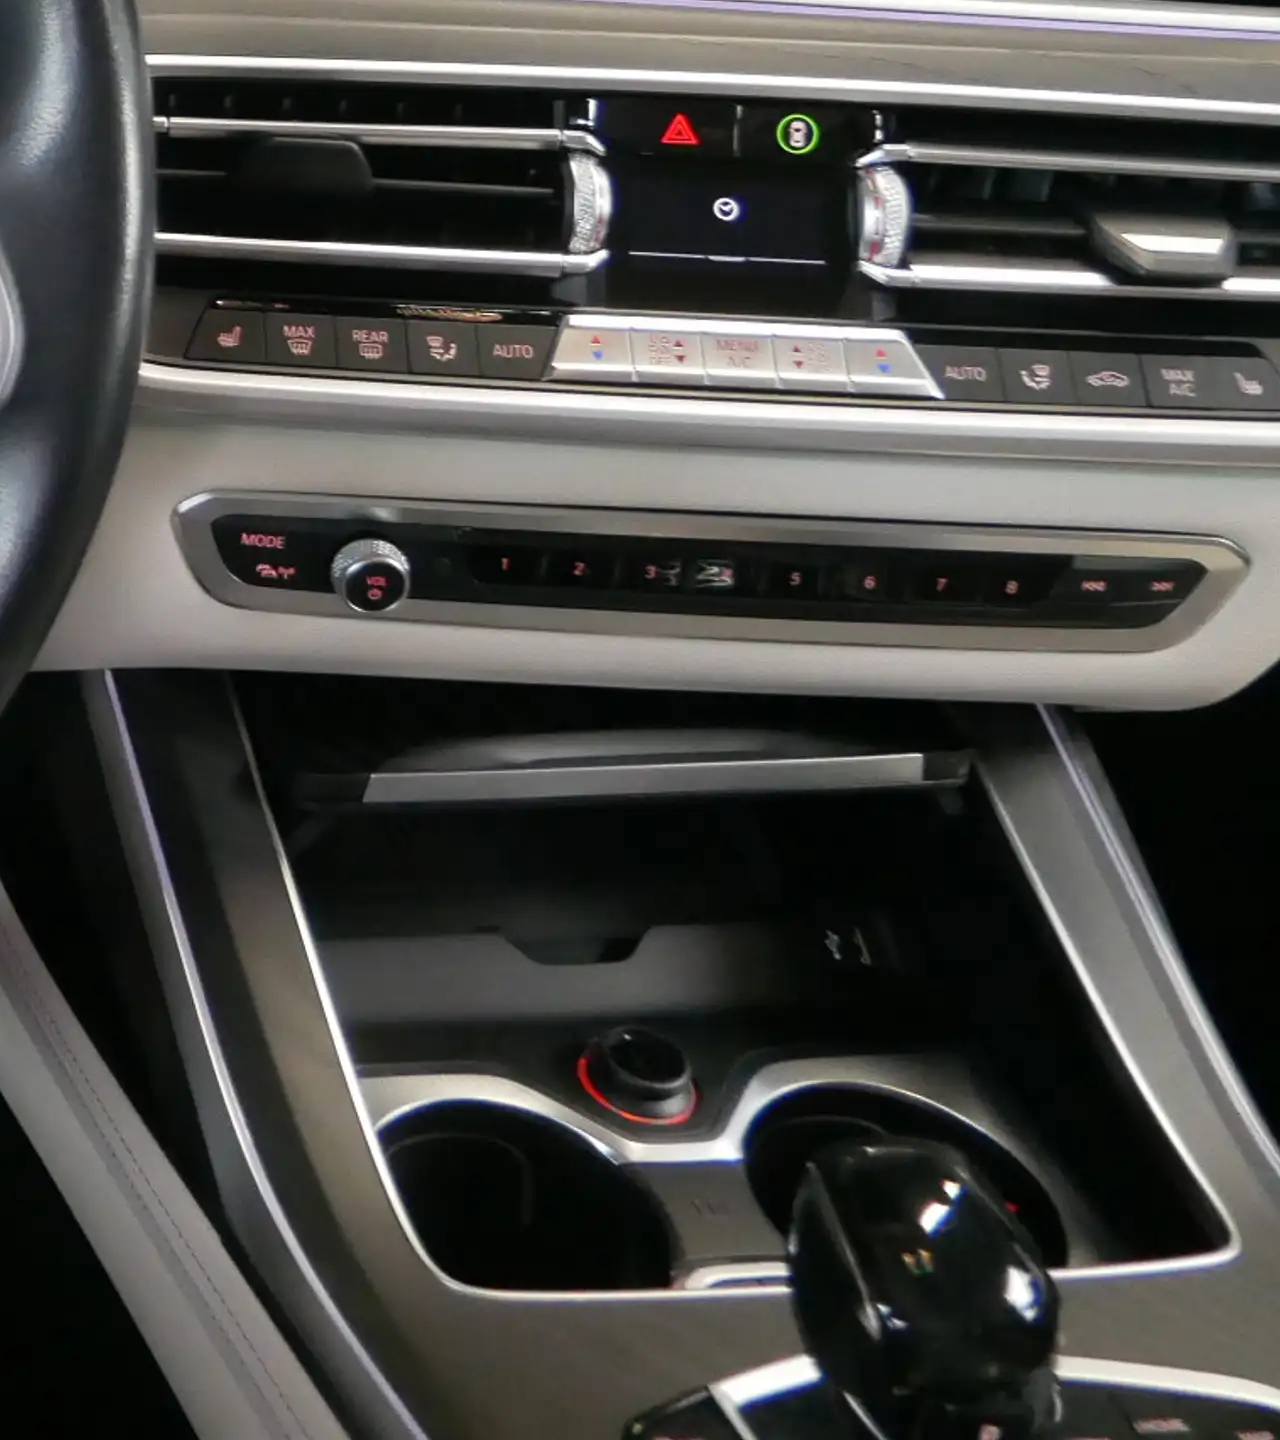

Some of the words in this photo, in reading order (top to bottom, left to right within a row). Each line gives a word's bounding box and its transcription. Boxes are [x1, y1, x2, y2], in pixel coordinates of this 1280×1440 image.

[283, 324, 316, 339] MAX
[352, 329, 390, 344] REAR
[493, 343, 533, 359] AUTO
[944, 365, 987, 382] AUTO
[240, 532, 286, 549] MODE
[644, 565, 658, 579] 3
